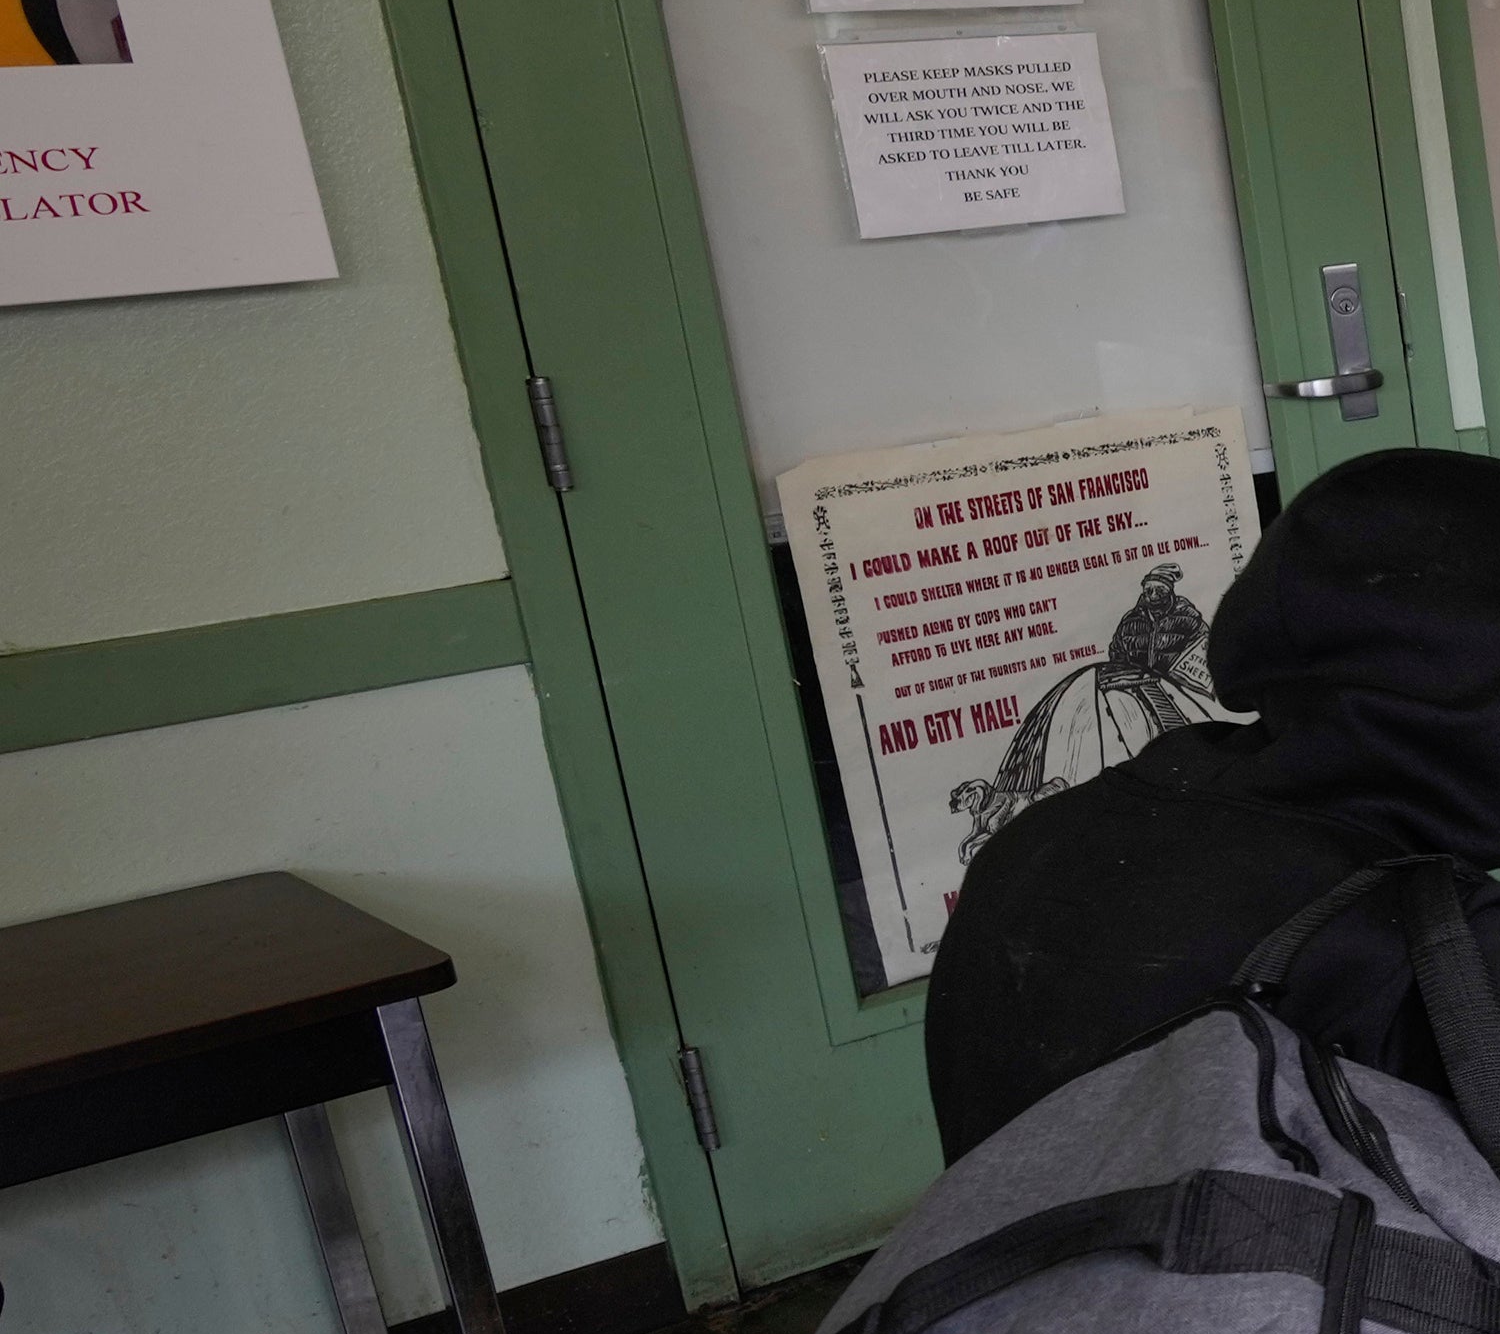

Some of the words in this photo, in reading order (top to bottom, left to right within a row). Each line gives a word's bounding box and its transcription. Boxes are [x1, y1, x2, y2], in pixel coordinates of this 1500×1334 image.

[864, 69, 919, 83] PLEASE
[923, 68, 960, 80] KEEP
[964, 64, 1013, 78] MASKS
[1017, 62, 1071, 75] PULLED
[868, 91, 908, 104] OVER
[912, 87, 966, 102] MOUTH
[971, 85, 1001, 97] AND
[1005, 82, 1048, 96] NOSE.
[1051, 80, 1075, 93] WE
[864, 112, 903, 125] WILL
[906, 110, 935, 122] ASK
[937, 107, 967, 119] YOU
[971, 104, 1019, 118] TWICE
[1022, 101, 1052, 114] AND
[1055, 99, 1085, 111] THE
[887, 129, 934, 143] THIRD
[938, 127, 975, 139] TIME
[978, 124, 1008, 137] YOU
[1012, 122, 1049, 134] WILL
[1052, 120, 1070, 131] BE
[878, 150, 926, 165] ASKED
[929, 148, 950, 161] TO
[954, 145, 999, 159] LEAVE
[1002, 142, 1034, 154] TILL
[1037, 139, 1087, 152] LATER.
[945, 168, 996, 182] THANK
[999, 165, 1029, 177] YOU
[964, 191, 982, 203] BE
[986, 187, 1020, 201] SAFE
[913, 506, 934, 529] ON
[937, 501, 964, 524] THE
[967, 490, 1023, 520] STREETS
[1027, 487, 1043, 510] OF
[1048, 481, 1074, 506] SAN
[1078, 468, 1149, 501] FRANCISCO
[850, 563, 858, 580] I
[863, 552, 912, 578] COULD
[917, 544, 961, 569] MAKE
[967, 542, 979, 559] A
[983, 534, 1018, 558] ROOF
[1024, 527, 1050, 549] OUT
[1055, 524, 1071, 543] OF
[1075, 517, 1102, 538] THE
[1108, 511, 1148, 532] SKY...
[874, 597, 880, 611] I
[884, 590, 917, 608] COULD
[921, 582, 962, 602] SHELTER
[966, 576, 1000, 594] WHERE
[1003, 573, 1013, 587] IT
[1030, 567, 1043, 581] NO
[1047, 560, 1080, 578] LONGER
[1083, 556, 1109, 571] LEGAL
[1112, 550, 1122, 564] TO
[1125, 548, 1138, 561] SIT
[1142, 545, 1154, 557] OR
[1158, 541, 1170, 555] LIE
[1174, 535, 1210, 551] DOWN...
[877, 626, 919, 645] PUSHED
[923, 619, 954, 637] ALONG
[958, 615, 971, 630] BY
[975, 610, 1000, 626] COPS
[1004, 604, 1026, 620] WHO
[1029, 598, 1057, 615] CAN'T
[891, 648, 931, 667] AFFORD
[935, 643, 947, 658] TO
[951, 639, 972, 655] LIVE
[976, 634, 1001, 650] HERE
[1004, 628, 1023, 644] ANY
[1028, 622, 1058, 638] MORE.
[895, 685, 912, 699] OUT
[915, 683, 925, 694] OF
[930, 677, 954, 692] SIGHT
[957, 674, 967, 685] OF
[970, 670, 986, 682] THE
[989, 660, 1027, 678] TOURISTS
[1030, 656, 1046, 670] AND
[1053, 653, 1067, 664] THE
[1180, 661, 1212, 681] SHEET
[879, 719, 918, 755] AND
[924, 708, 964, 745] CITY
[970, 695, 1021, 734] HALL!
